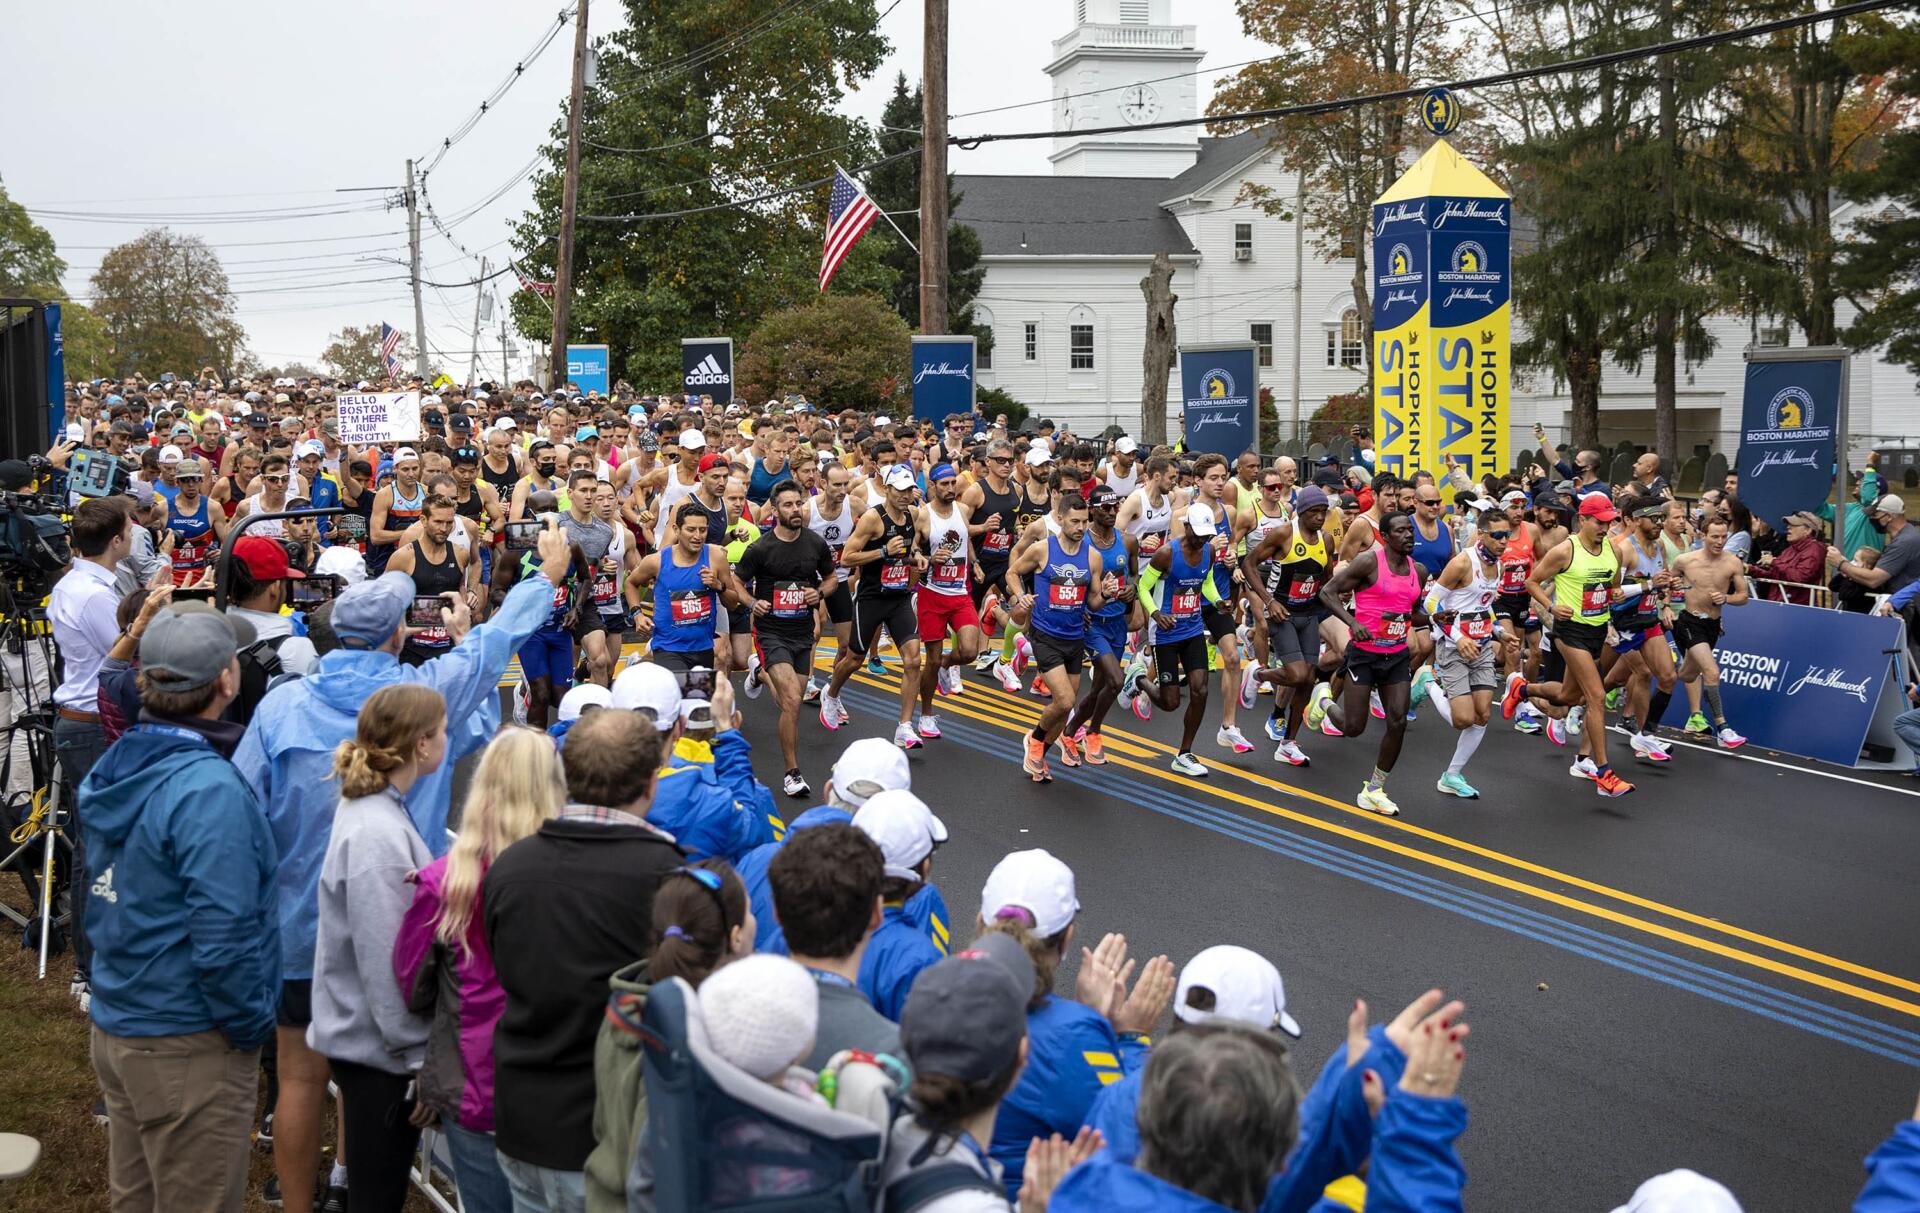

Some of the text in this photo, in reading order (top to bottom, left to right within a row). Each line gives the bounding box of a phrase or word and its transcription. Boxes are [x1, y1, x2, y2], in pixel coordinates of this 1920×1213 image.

[1376, 202, 1427, 237] John Hancock
[1433, 200, 1507, 229] John Hancock
[1380, 276, 1397, 284] BOSTON
[1438, 273, 1500, 281] BOSTON MARATHON
[685, 374, 729, 385] adidas
[913, 363, 939, 384] John
[340, 396, 377, 405] HELLO
[340, 405, 386, 415] BOSTON
[1409, 351, 1420, 471] HOPKINT
[1481, 351, 1496, 472] HOPKINT
[340, 414, 388, 424] I'M HERE
[1438, 337, 1473, 514] STAR
[356, 424, 377, 432] RUN
[341, 432, 391, 442] THIS CITY!
[1747, 430, 1830, 441] BOSTON MARATHON
[1751, 448, 1819, 477] John Hancock
[780, 591, 804, 604] 2439
[1059, 586, 1077, 600] 554
[681, 599, 701, 614] 565
[1719, 650, 1780, 673] BOSTON
[1720, 668, 1774, 691] ATHON
[1787, 665, 1873, 703] John Hancock
